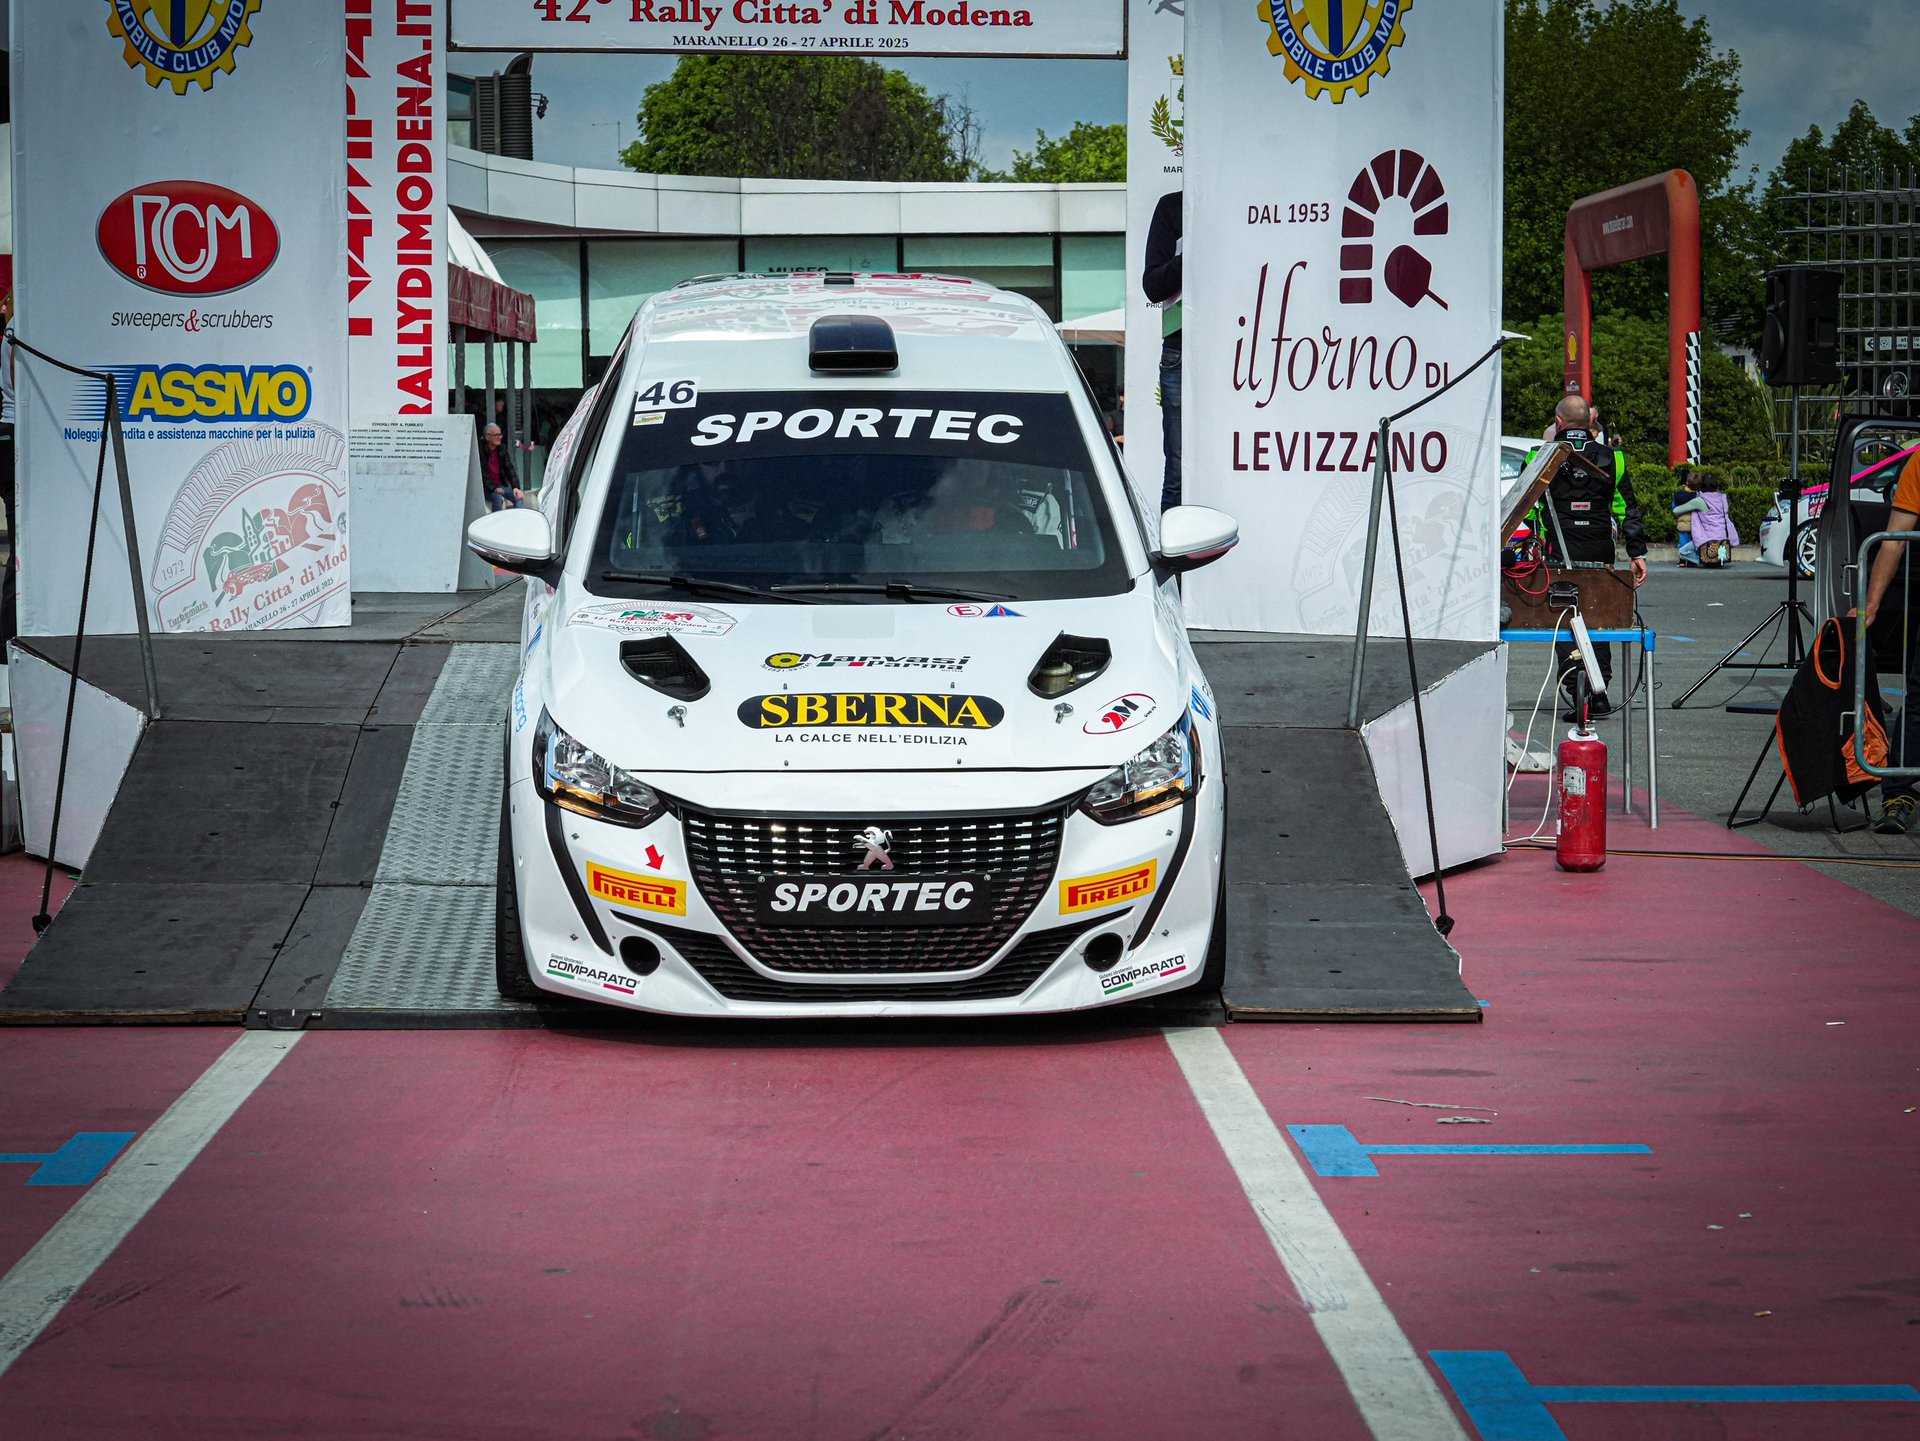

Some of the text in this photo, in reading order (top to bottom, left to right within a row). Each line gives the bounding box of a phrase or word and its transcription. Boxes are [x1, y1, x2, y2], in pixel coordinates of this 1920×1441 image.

[629, 0, 722, 32] Rally
[844, 0, 879, 24] di
[888, 1, 1033, 26] Modena
[173, 39, 221, 72] CLUB
[672, 35, 768, 47] MARANELLO
[773, 36, 788, 47] 26
[800, 37, 816, 47] 27
[819, 37, 874, 48] APRILE
[878, 37, 909, 48] 2025
[1331, 43, 1376, 81] CLUB
[1375, 1, 1397, 43] MO
[1248, 202, 1331, 225] DAL 1953
[133, 195, 252, 283] RCM
[1425, 362, 1449, 388] DI
[128, 371, 308, 417] ASSMO
[638, 380, 696, 406] 46
[148, 431, 154, 439] e
[157, 428, 206, 439] assistenza
[209, 428, 253, 439] macchine
[256, 430, 272, 442] per
[274, 428, 283, 439] la
[286, 428, 315, 442] pulizia
[690, 408, 1024, 446] SPORTEC
[1232, 431, 1448, 473] LEVIZZANO
[162, 562, 185, 581] 1972
[300, 566, 315, 586] di
[280, 604, 287, 614] 26
[291, 599, 299, 610] 27
[299, 586, 321, 603] APRILE
[321, 577, 334, 589] 2025
[167, 600, 209, 628] Turbomark
[608, 624, 684, 633] CONCORRENTE
[801, 653, 971, 665] Marvasi
[760, 694, 992, 728] SBERNA
[775, 734, 968, 746] LA CALCE NELL'EDILIZIA
[593, 870, 677, 908] PIRELLI
[770, 881, 974, 912] SPORTEC
[1068, 868, 1150, 907] PIRELLI
[548, 959, 637, 988] COMPARATO
[1101, 955, 1185, 989] COMPARATO
